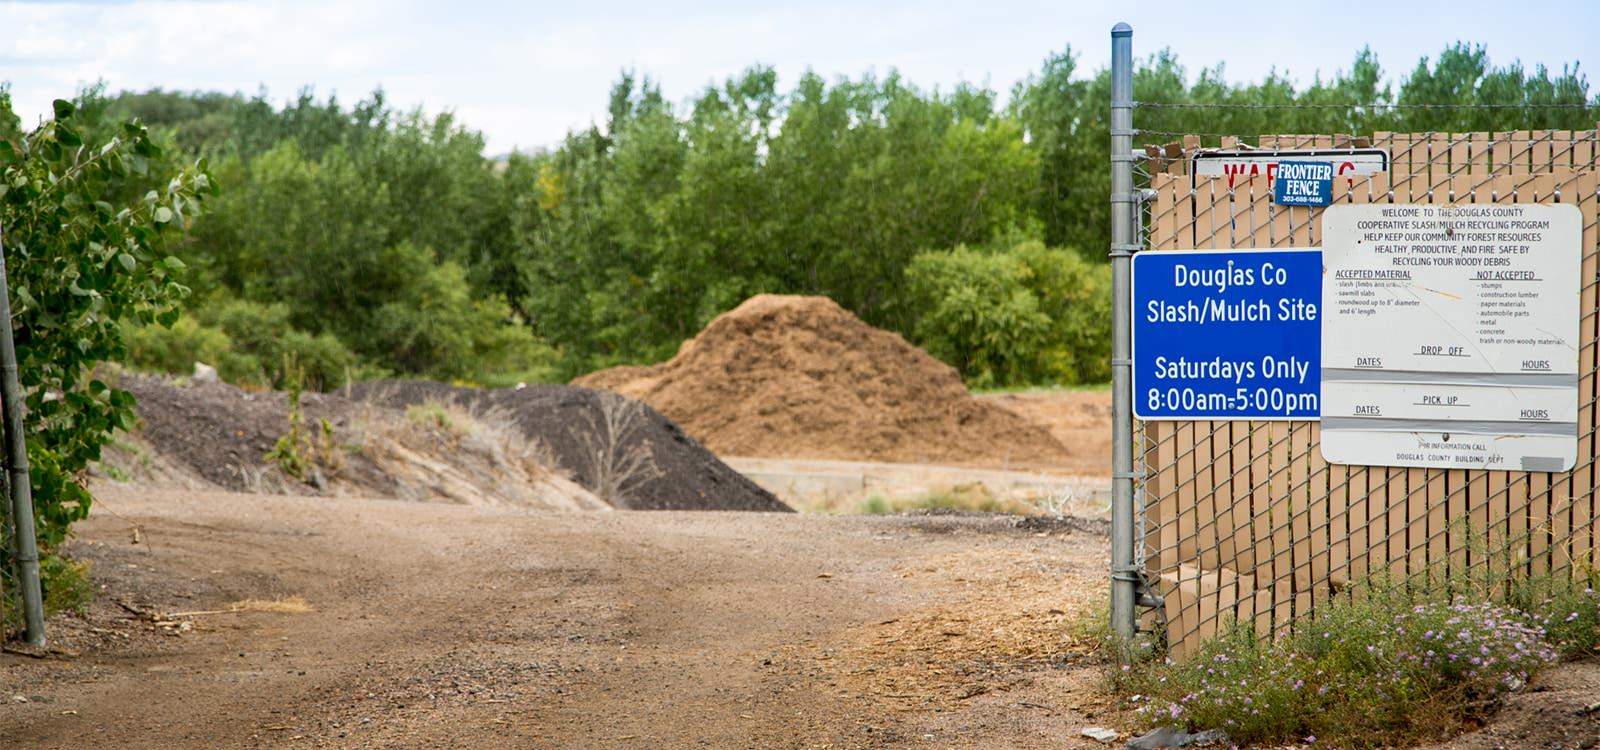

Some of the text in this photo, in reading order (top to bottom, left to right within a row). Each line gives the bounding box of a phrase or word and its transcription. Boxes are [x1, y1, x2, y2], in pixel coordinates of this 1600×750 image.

[1278, 164, 1332, 180] FRONTIER
[1286, 180, 1320, 196] FENCE
[1382, 208, 1524, 217] WELCOME TO THE DOUGLAS COUNTY
[1357, 220, 1411, 230] COOPERATIVE
[1467, 220, 1509, 230] RECYCLING
[1511, 220, 1550, 230] PROGRAM
[1364, 233, 1542, 242] HELP KEEP OUR COMMUNITY FOREST RESOURCES
[1461, 245, 1478, 254] AND
[1479, 245, 1495, 254] FIRE
[1499, 245, 1518, 254] SAFE
[1520, 245, 1530, 254] BY
[1392, 257, 1511, 266] RECYCLING YOUR WOODY DEBRIS
[1175, 262, 1287, 293] Douglas Co
[1335, 269, 1412, 279] ACCEPTED MATERIAL
[1476, 270, 1535, 280] NOT ACCEPTED
[1147, 297, 1317, 324] Slash/Mulch Site
[1357, 307, 1376, 316] length
[1503, 338, 1536, 346] non-woody
[1421, 346, 1464, 356] DROP OFF
[1356, 357, 1382, 367] DATES
[1522, 360, 1550, 369] HOURS
[1155, 355, 1309, 384] Saturdays Only
[1148, 387, 1317, 415] 8:00am-5:00pm
[1423, 395, 1459, 405] PICK UP
[1355, 405, 1381, 415] DATES
[1520, 409, 1549, 419] HOURS
[1431, 442, 1471, 451] INFORMATION
[1396, 453, 1424, 461] DOUGLAS
[1428, 454, 1451, 462] COUNTY
[1455, 455, 1484, 463] BUILDING
